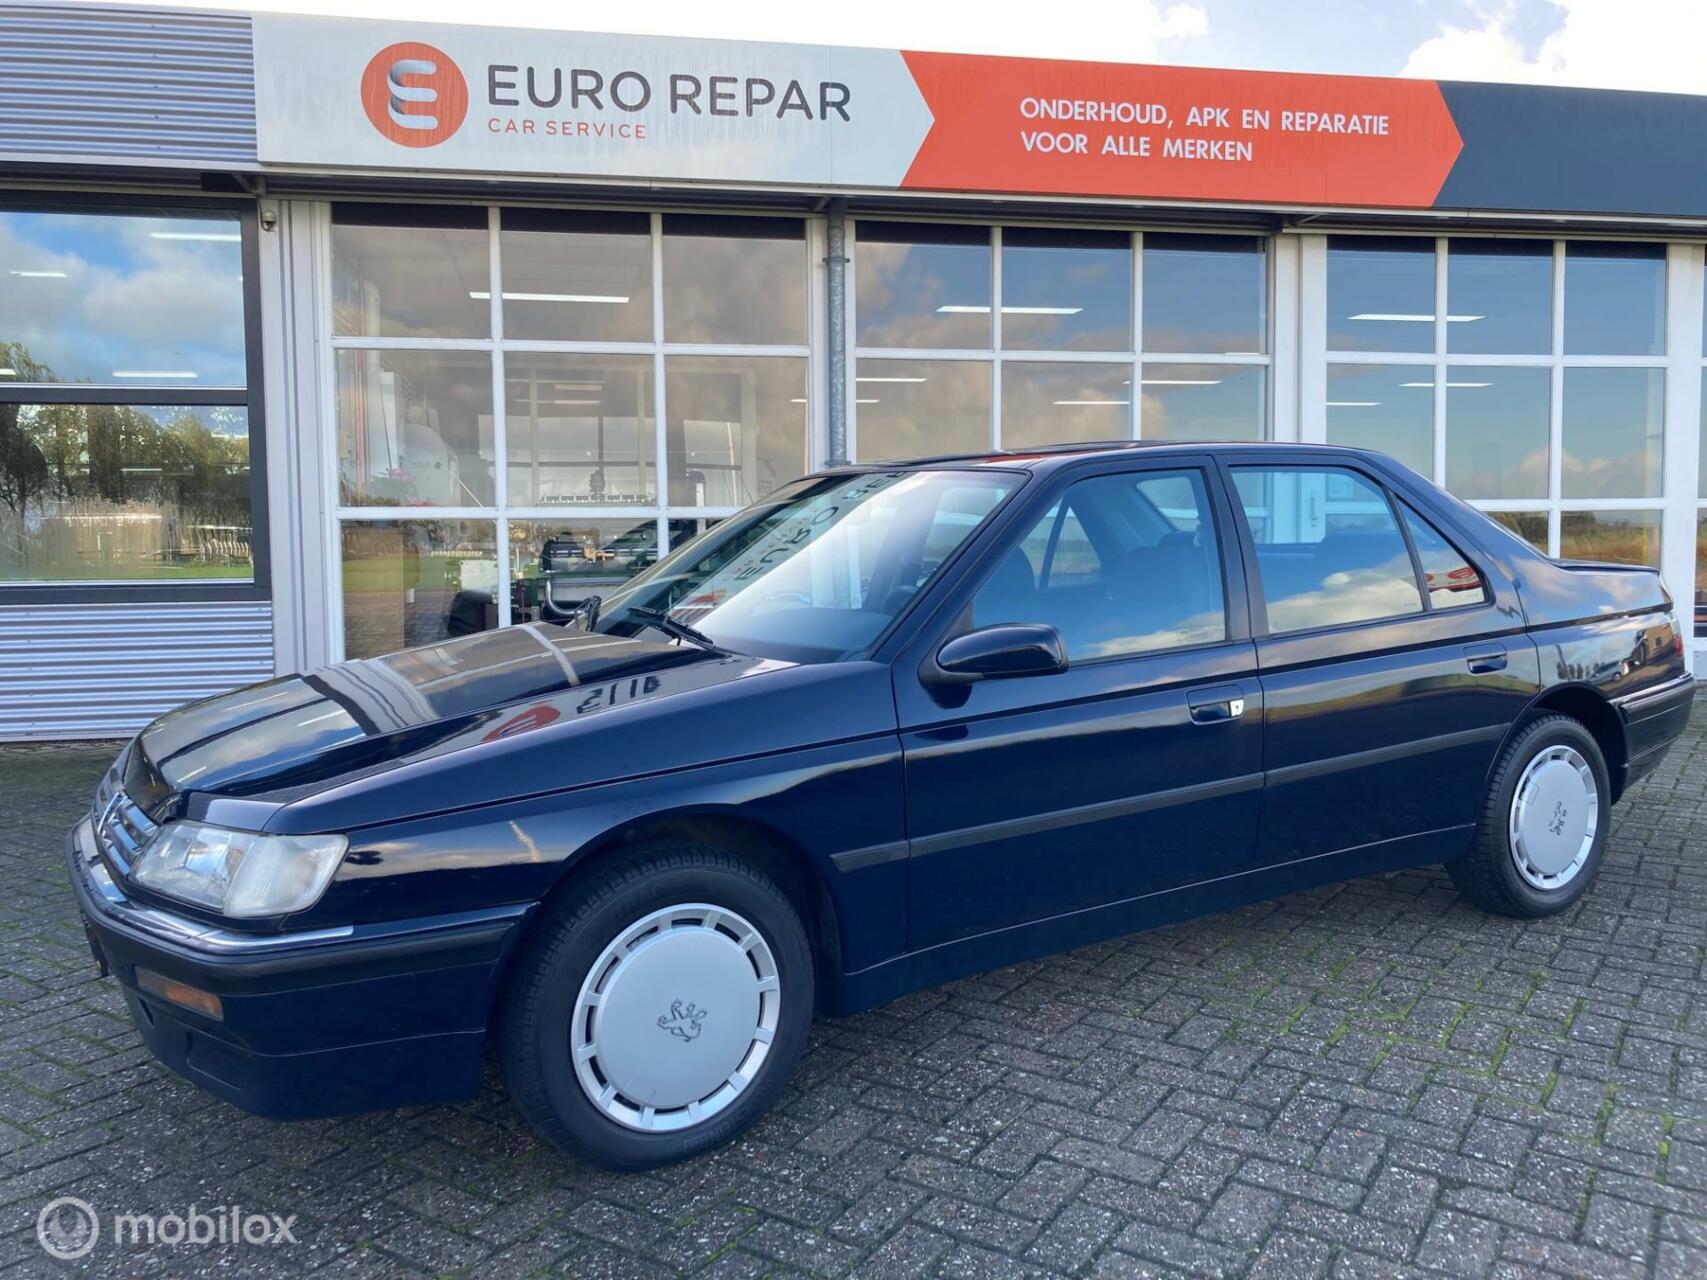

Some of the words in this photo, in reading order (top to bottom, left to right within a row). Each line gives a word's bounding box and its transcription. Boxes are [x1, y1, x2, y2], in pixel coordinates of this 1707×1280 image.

[488, 65, 651, 112] EURO
[669, 74, 851, 122] REPAR
[488, 118, 535, 134] CAR
[546, 120, 646, 139] SERVICE
[1019, 97, 1174, 129] ONDERHOUD,
[1186, 107, 1230, 128] APK
[1242, 109, 1270, 130] EN
[1281, 111, 1389, 136] REPARATIE
[1020, 131, 1088, 154] VOOR
[1101, 135, 1150, 157] ALLE
[1163, 138, 1253, 161] MERKEN
